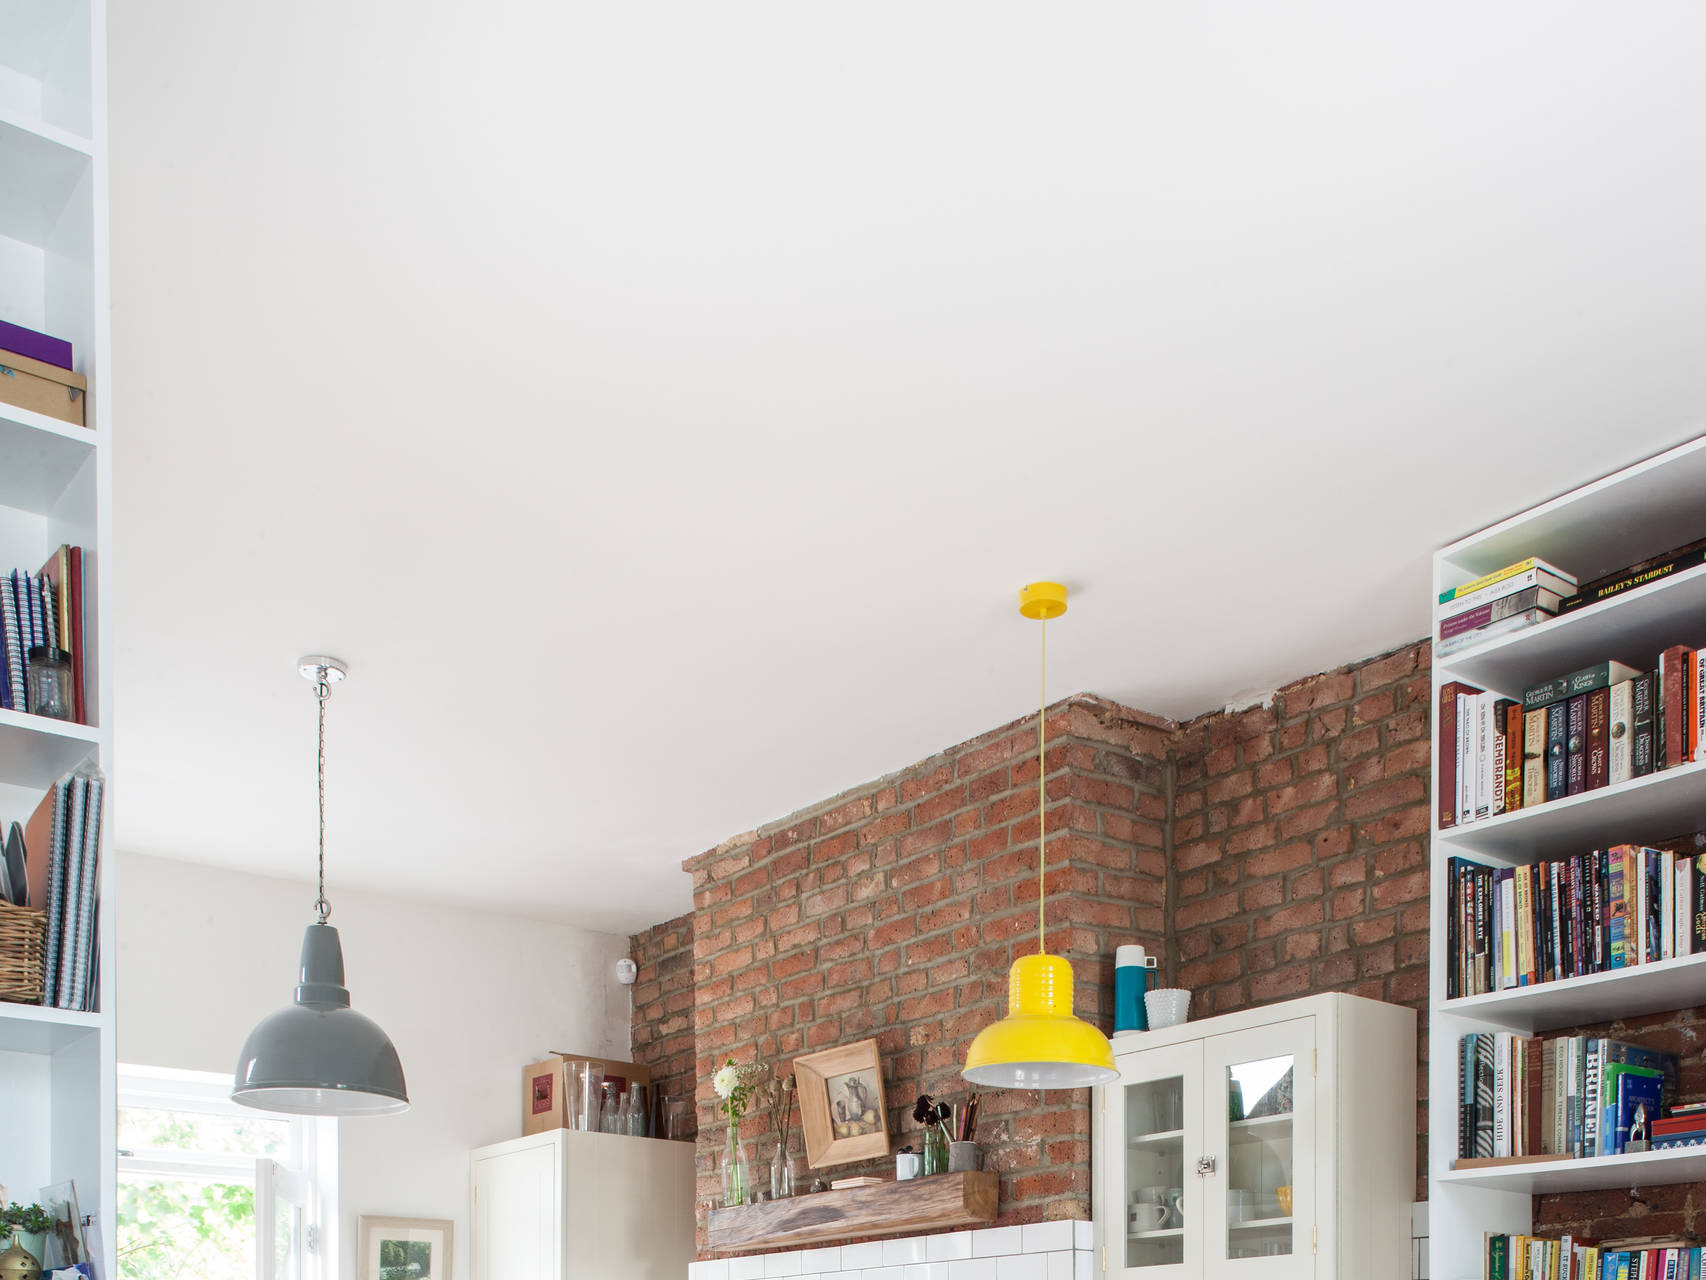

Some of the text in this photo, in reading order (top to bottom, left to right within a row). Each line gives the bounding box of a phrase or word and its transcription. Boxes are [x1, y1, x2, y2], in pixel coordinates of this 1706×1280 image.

[1598, 563, 1675, 597] BAILEY'S STARDUST
[1699, 658, 1705, 669] OF
[1526, 690, 1555, 707] MARTIN
[1573, 679, 1593, 691] KINGS
[1635, 681, 1645, 715] MARTIN
[1551, 708, 1560, 740] MARTIN
[1569, 702, 1578, 735] MARTIN
[1591, 696, 1599, 729] MARTIN
[1528, 714, 1537, 746] MARTIN
[1494, 735, 1504, 803] REMBRANDT
[1496, 1068, 1504, 1142] HIDE AND SEEK
[1584, 1053, 1599, 1147] BRUNEL
[1667, 1260, 1675, 1277] BILL
